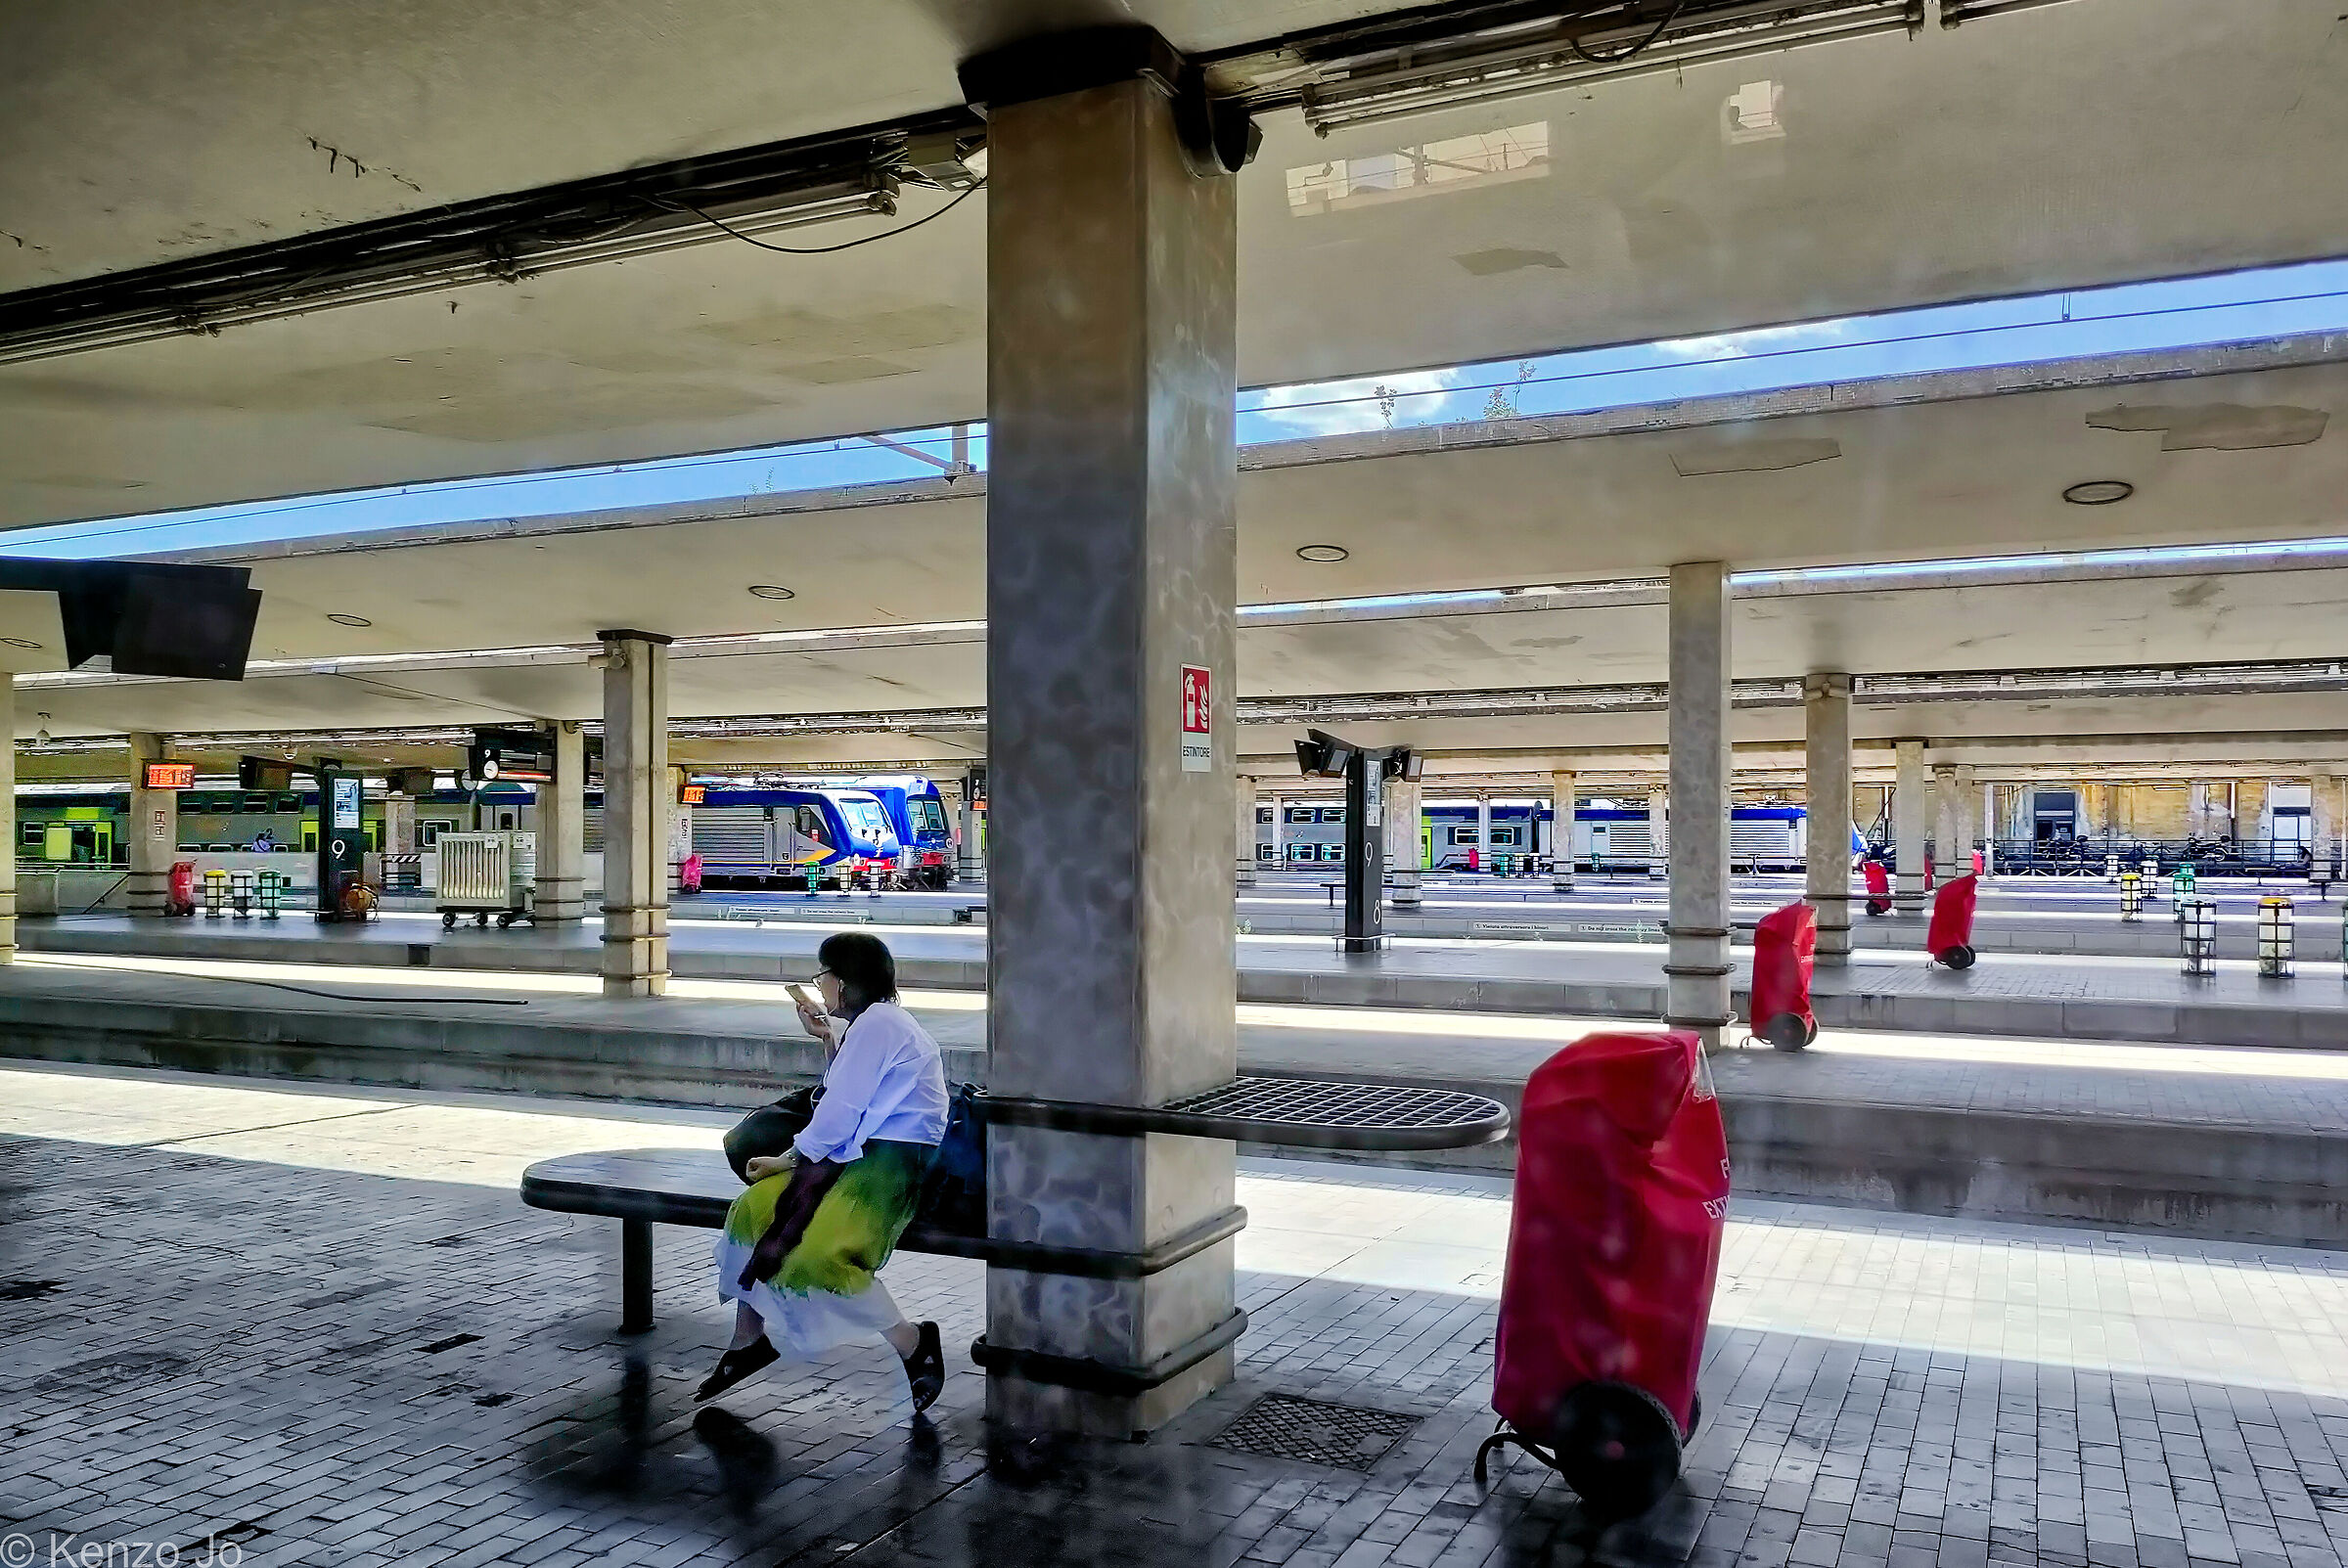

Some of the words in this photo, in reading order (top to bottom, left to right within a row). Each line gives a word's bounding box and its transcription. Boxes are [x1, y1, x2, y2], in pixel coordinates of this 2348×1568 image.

[484, 749, 491, 758] 9
[1182, 745, 1210, 758] ESTINTORE
[332, 839, 345, 860] 9
[1365, 841, 1374, 868] 9
[1373, 899, 1381, 924] 8
